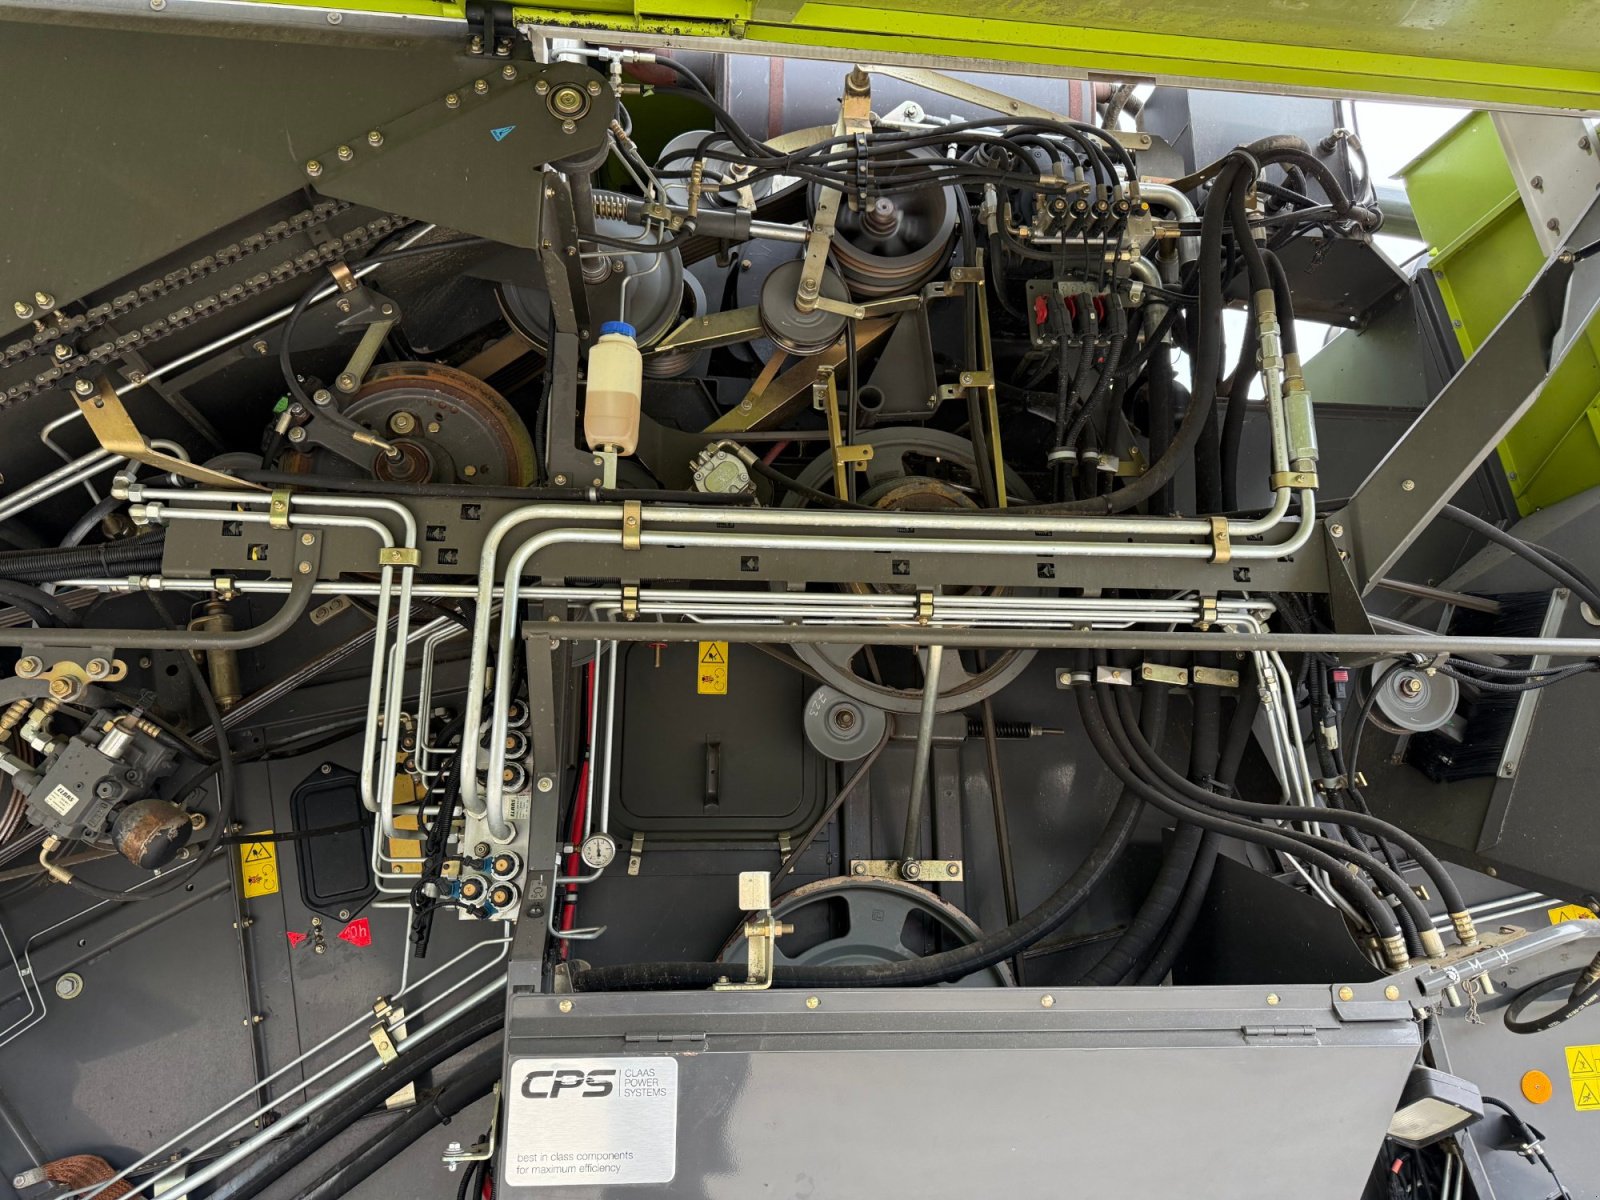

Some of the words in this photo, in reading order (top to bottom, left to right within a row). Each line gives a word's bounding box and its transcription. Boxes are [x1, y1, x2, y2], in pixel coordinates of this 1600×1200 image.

[624, 1069, 655, 1078] CLAAS
[521, 1069, 616, 1098] CPS
[624, 1078, 659, 1087] POWER
[624, 1088, 667, 1098] SYSTEMS
[517, 1153, 537, 1163] best
[540, 1153, 547, 1161] in
[550, 1152, 574, 1161] class
[576, 1152, 634, 1163] components
[516, 1164, 529, 1175] for
[532, 1164, 577, 1174] maximum
[579, 1163, 621, 1174] efficiency
